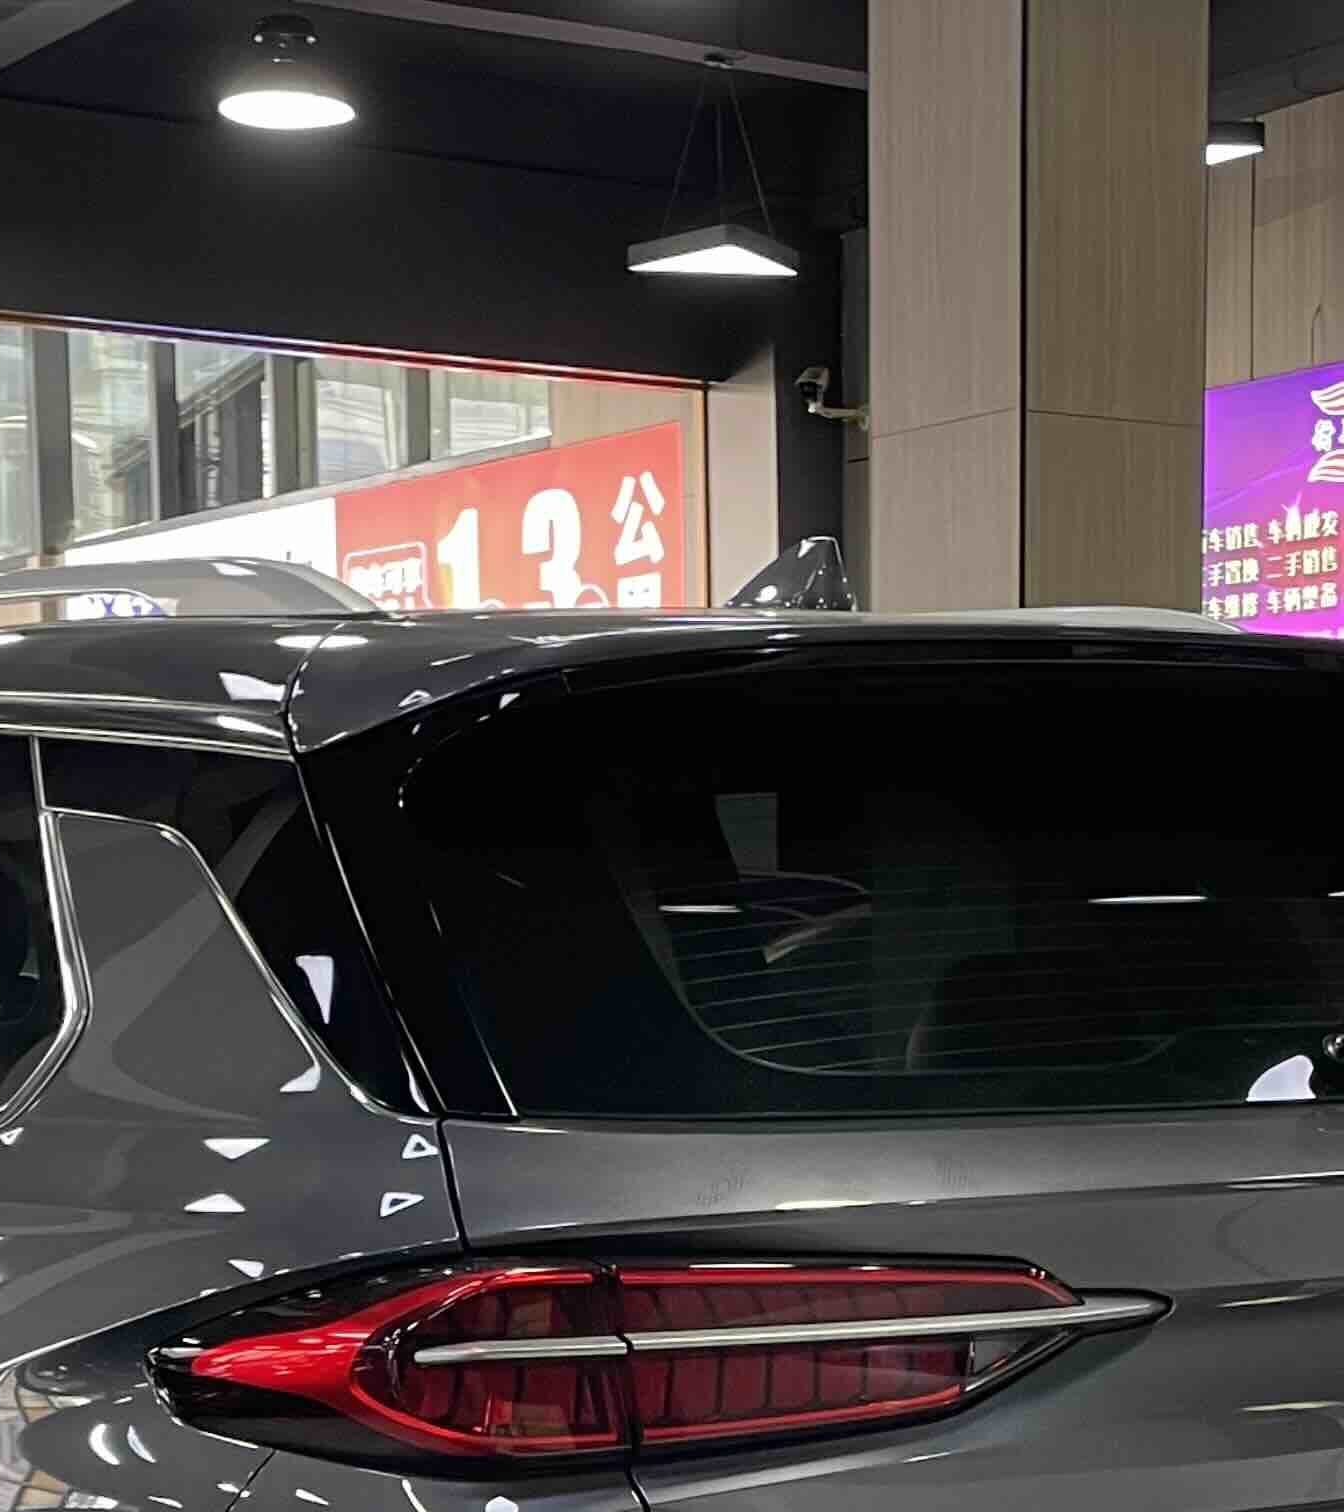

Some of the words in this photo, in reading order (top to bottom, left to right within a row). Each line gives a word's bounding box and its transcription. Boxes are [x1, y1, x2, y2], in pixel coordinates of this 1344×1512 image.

[1202, 558, 1259, 587] 手置换
[1266, 546, 1337, 578] 二手销售
[1202, 592, 1259, 620] 车维修
[1266, 582, 1337, 613] 车辆整备
